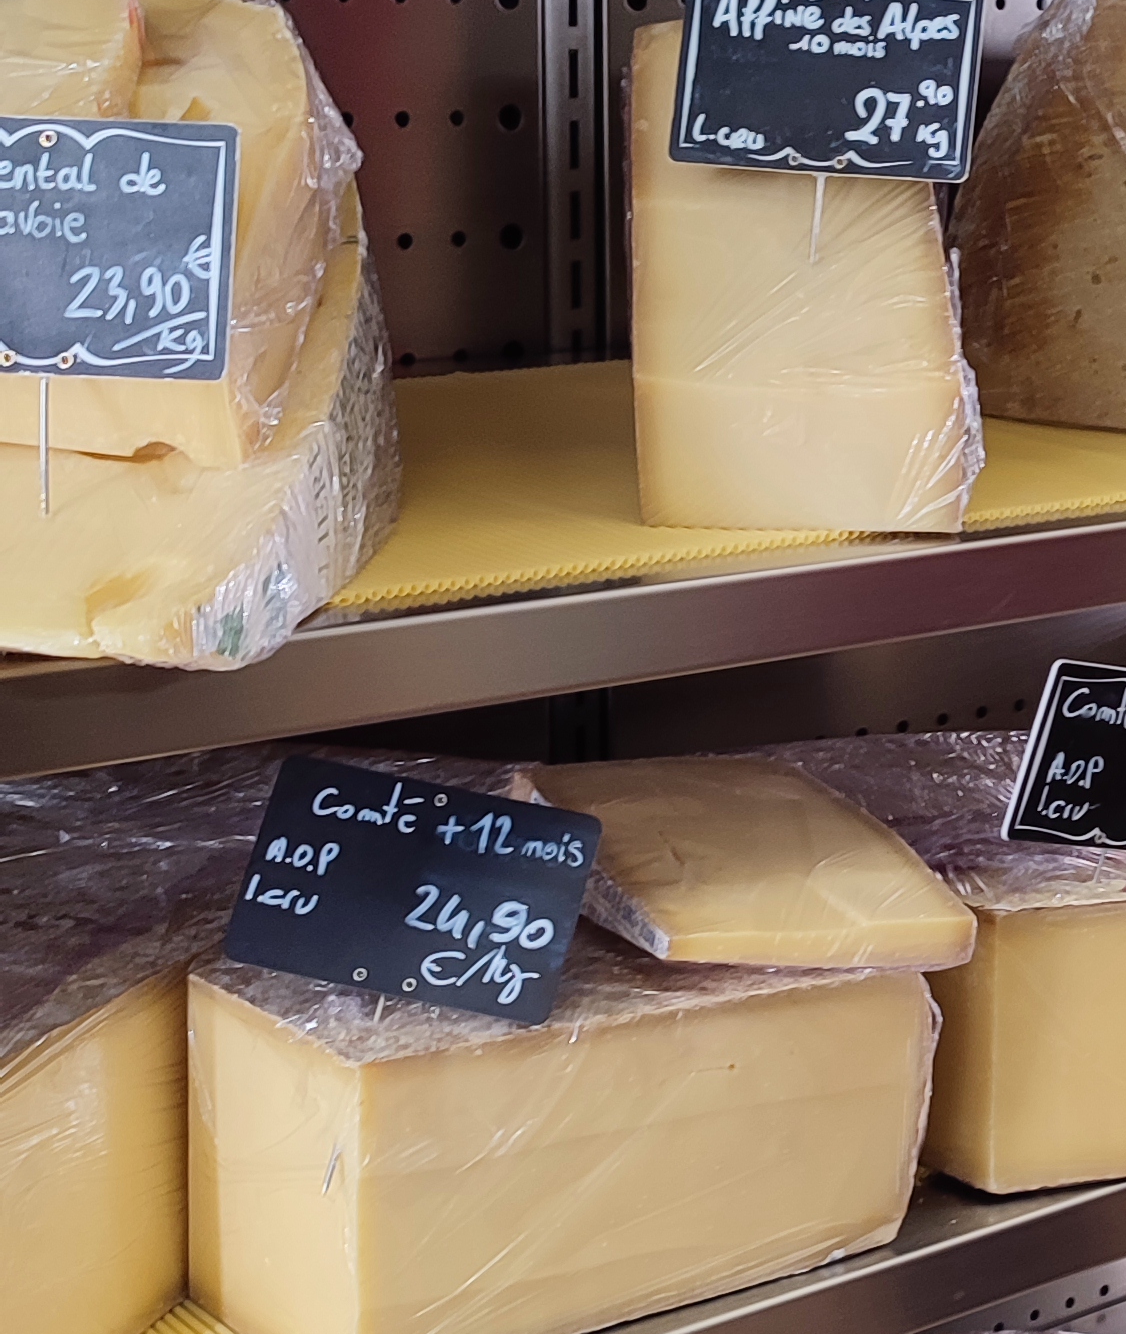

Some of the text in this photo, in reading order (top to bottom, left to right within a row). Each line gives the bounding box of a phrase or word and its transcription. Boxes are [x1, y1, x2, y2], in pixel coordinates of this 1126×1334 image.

[831, 6, 873, 36] des
[876, 2, 961, 50] Alpes
[832, 35, 887, 59] mois
[119, 151, 167, 195] de
[63, 266, 190, 325] 23,90
[312, 781, 425, 834] Comté
[520, 833, 585, 867] mois
[404, 884, 555, 950] 24,90
